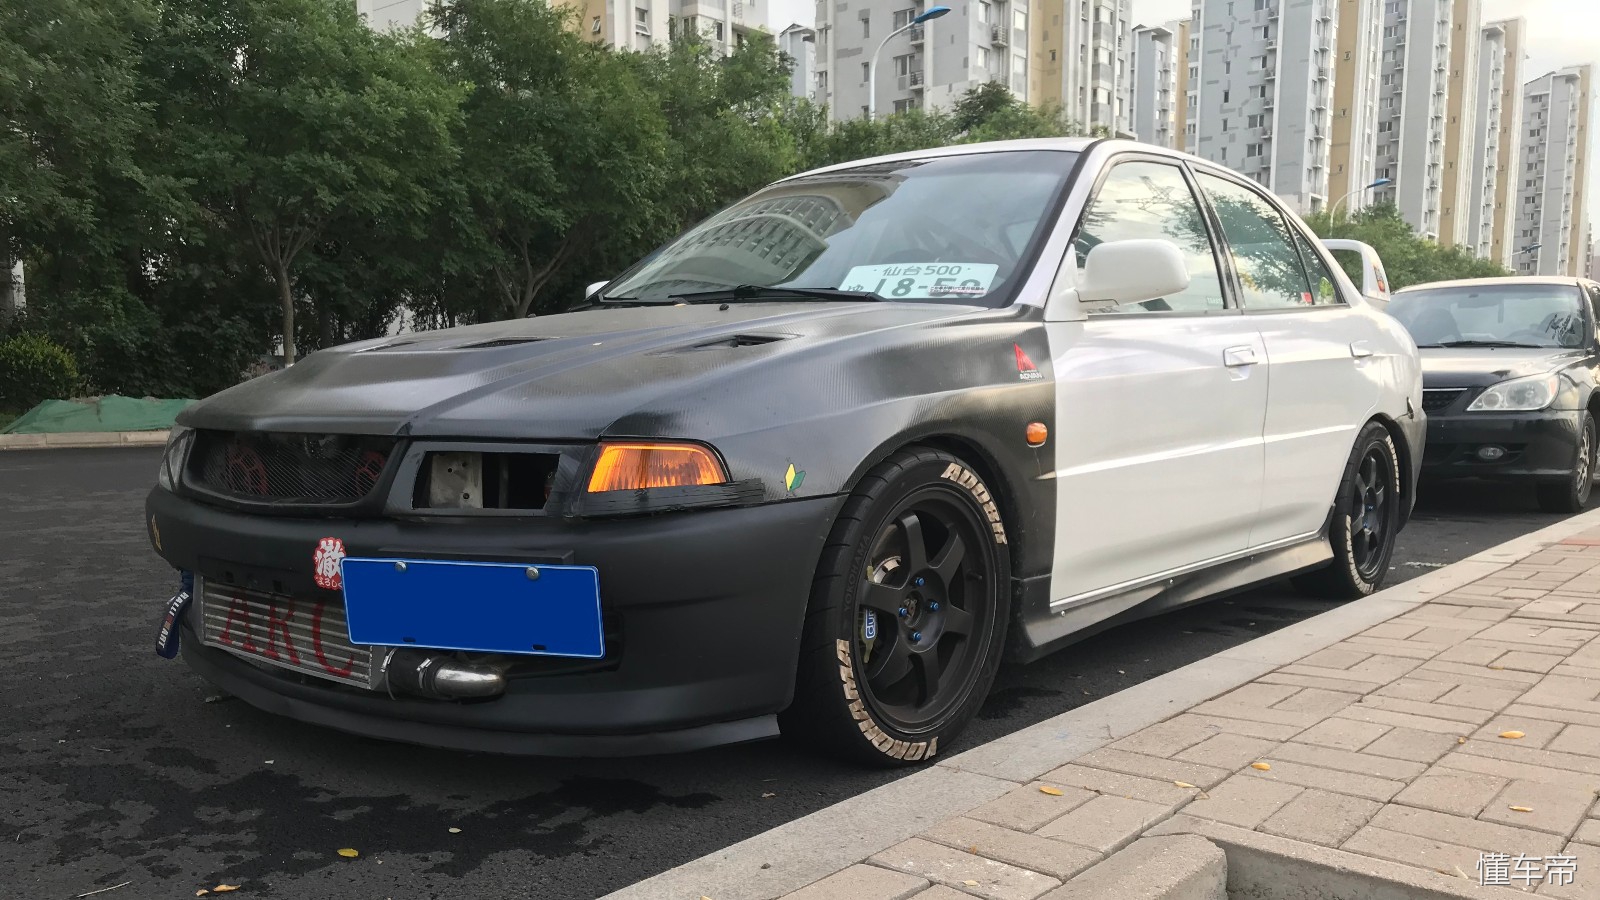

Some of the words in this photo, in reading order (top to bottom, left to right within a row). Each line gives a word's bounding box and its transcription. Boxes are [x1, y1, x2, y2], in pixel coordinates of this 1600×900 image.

[882, 265, 963, 276] 仙台500
[842, 534, 872, 613] YOKOHAMA
[168, 591, 190, 617] RALLI
[836, 637, 939, 762] YOKOHAMA
